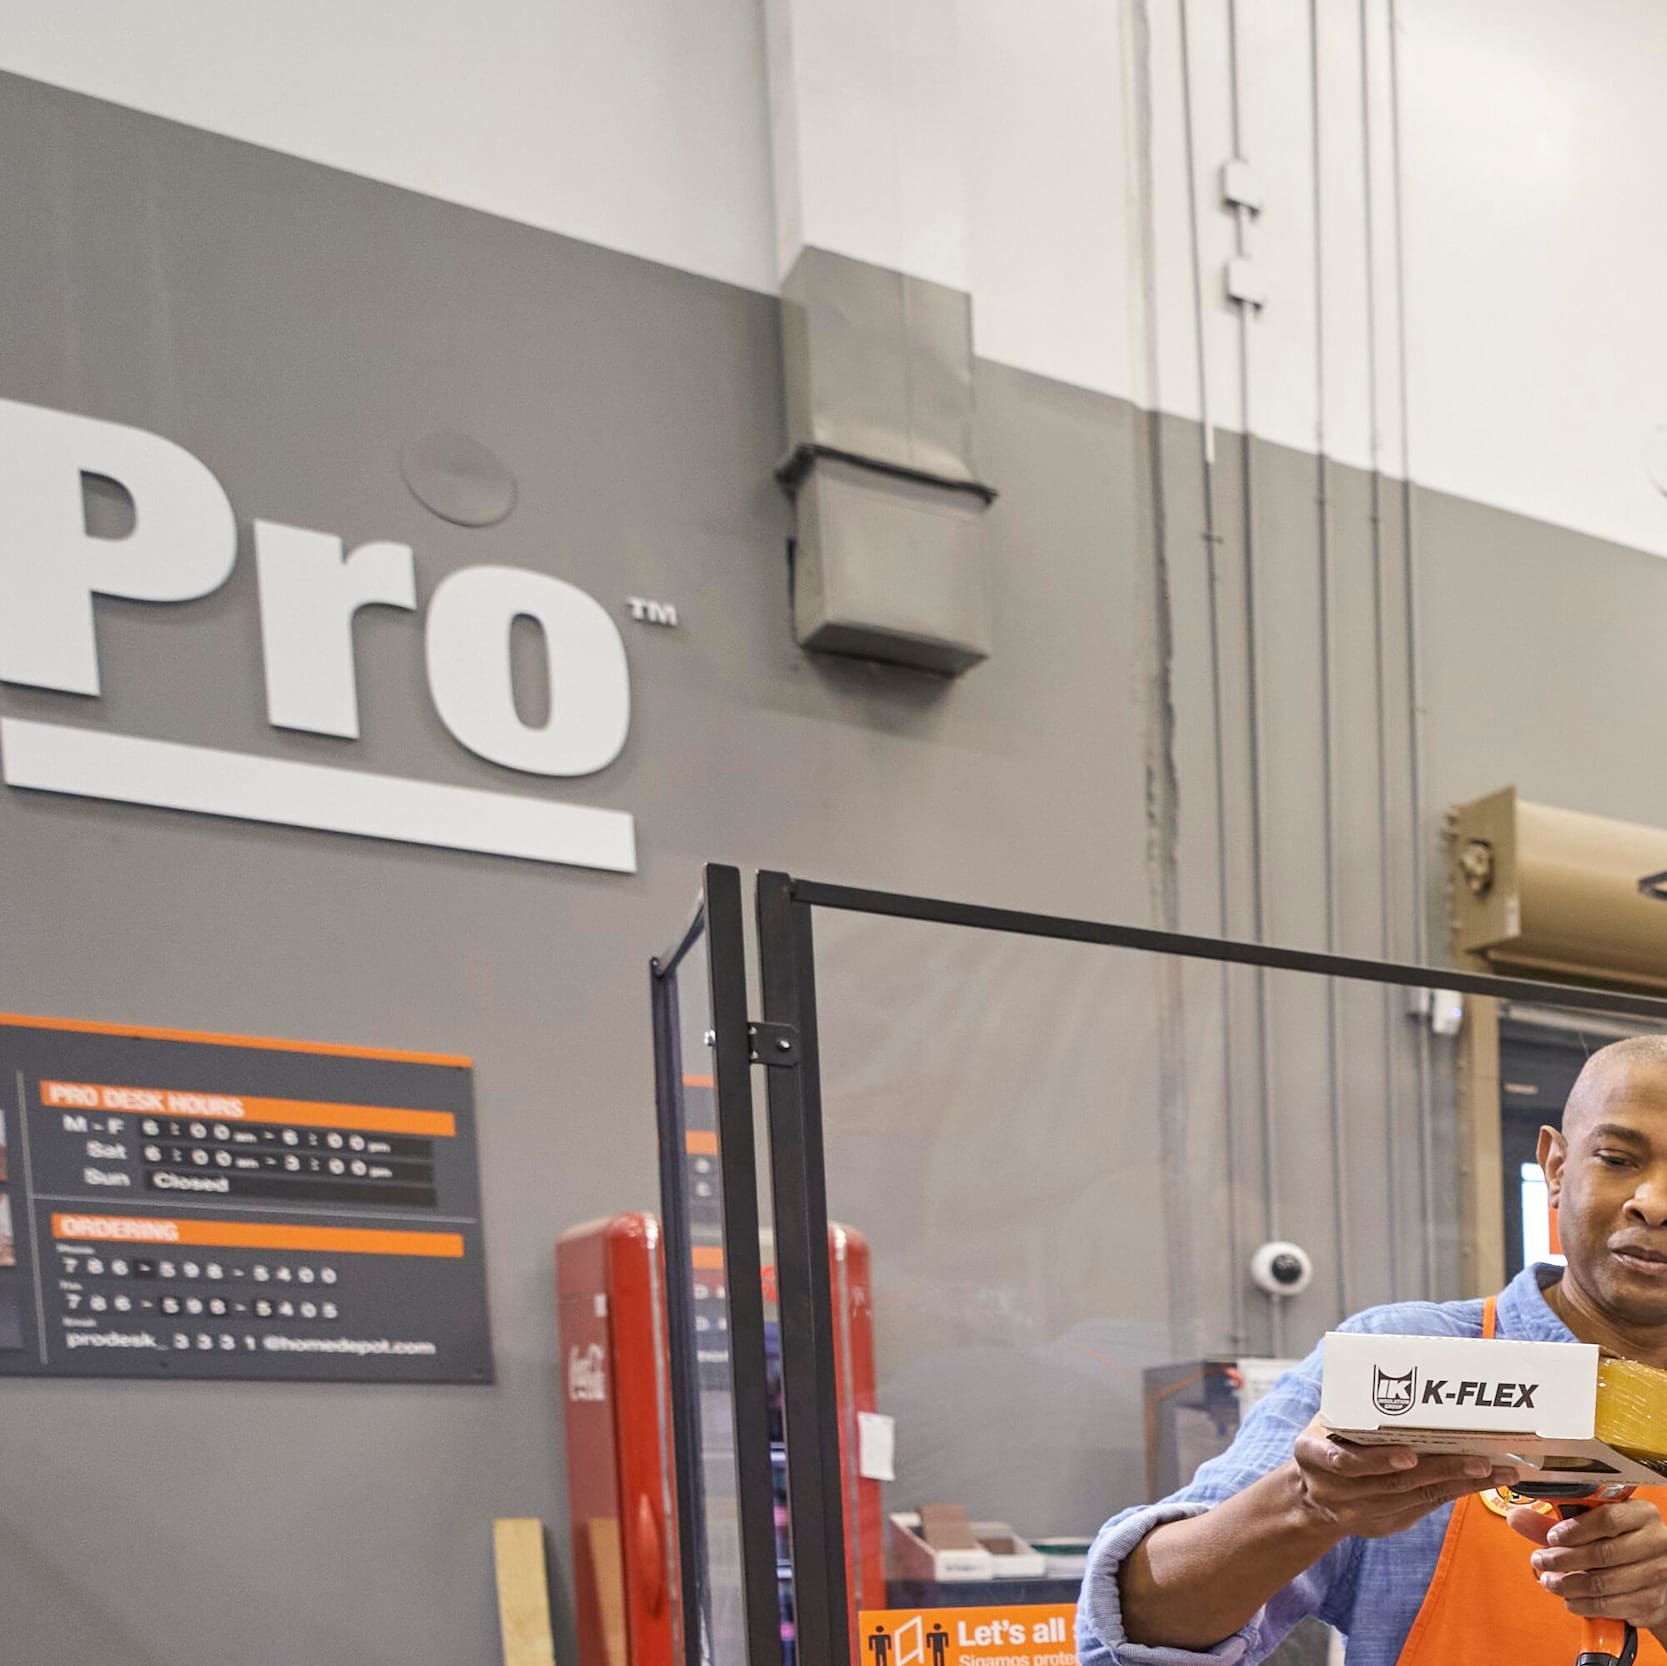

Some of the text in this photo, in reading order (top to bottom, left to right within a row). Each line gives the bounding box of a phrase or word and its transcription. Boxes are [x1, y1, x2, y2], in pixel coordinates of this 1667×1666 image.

[50, 1083, 245, 1118] PRO DESK HOURS
[152, 1171, 230, 1193] Closed
[60, 1216, 180, 1242] ORDERING
[1422, 1379, 1539, 1408] K-FLEX
[957, 1617, 1066, 1647] Let's all
